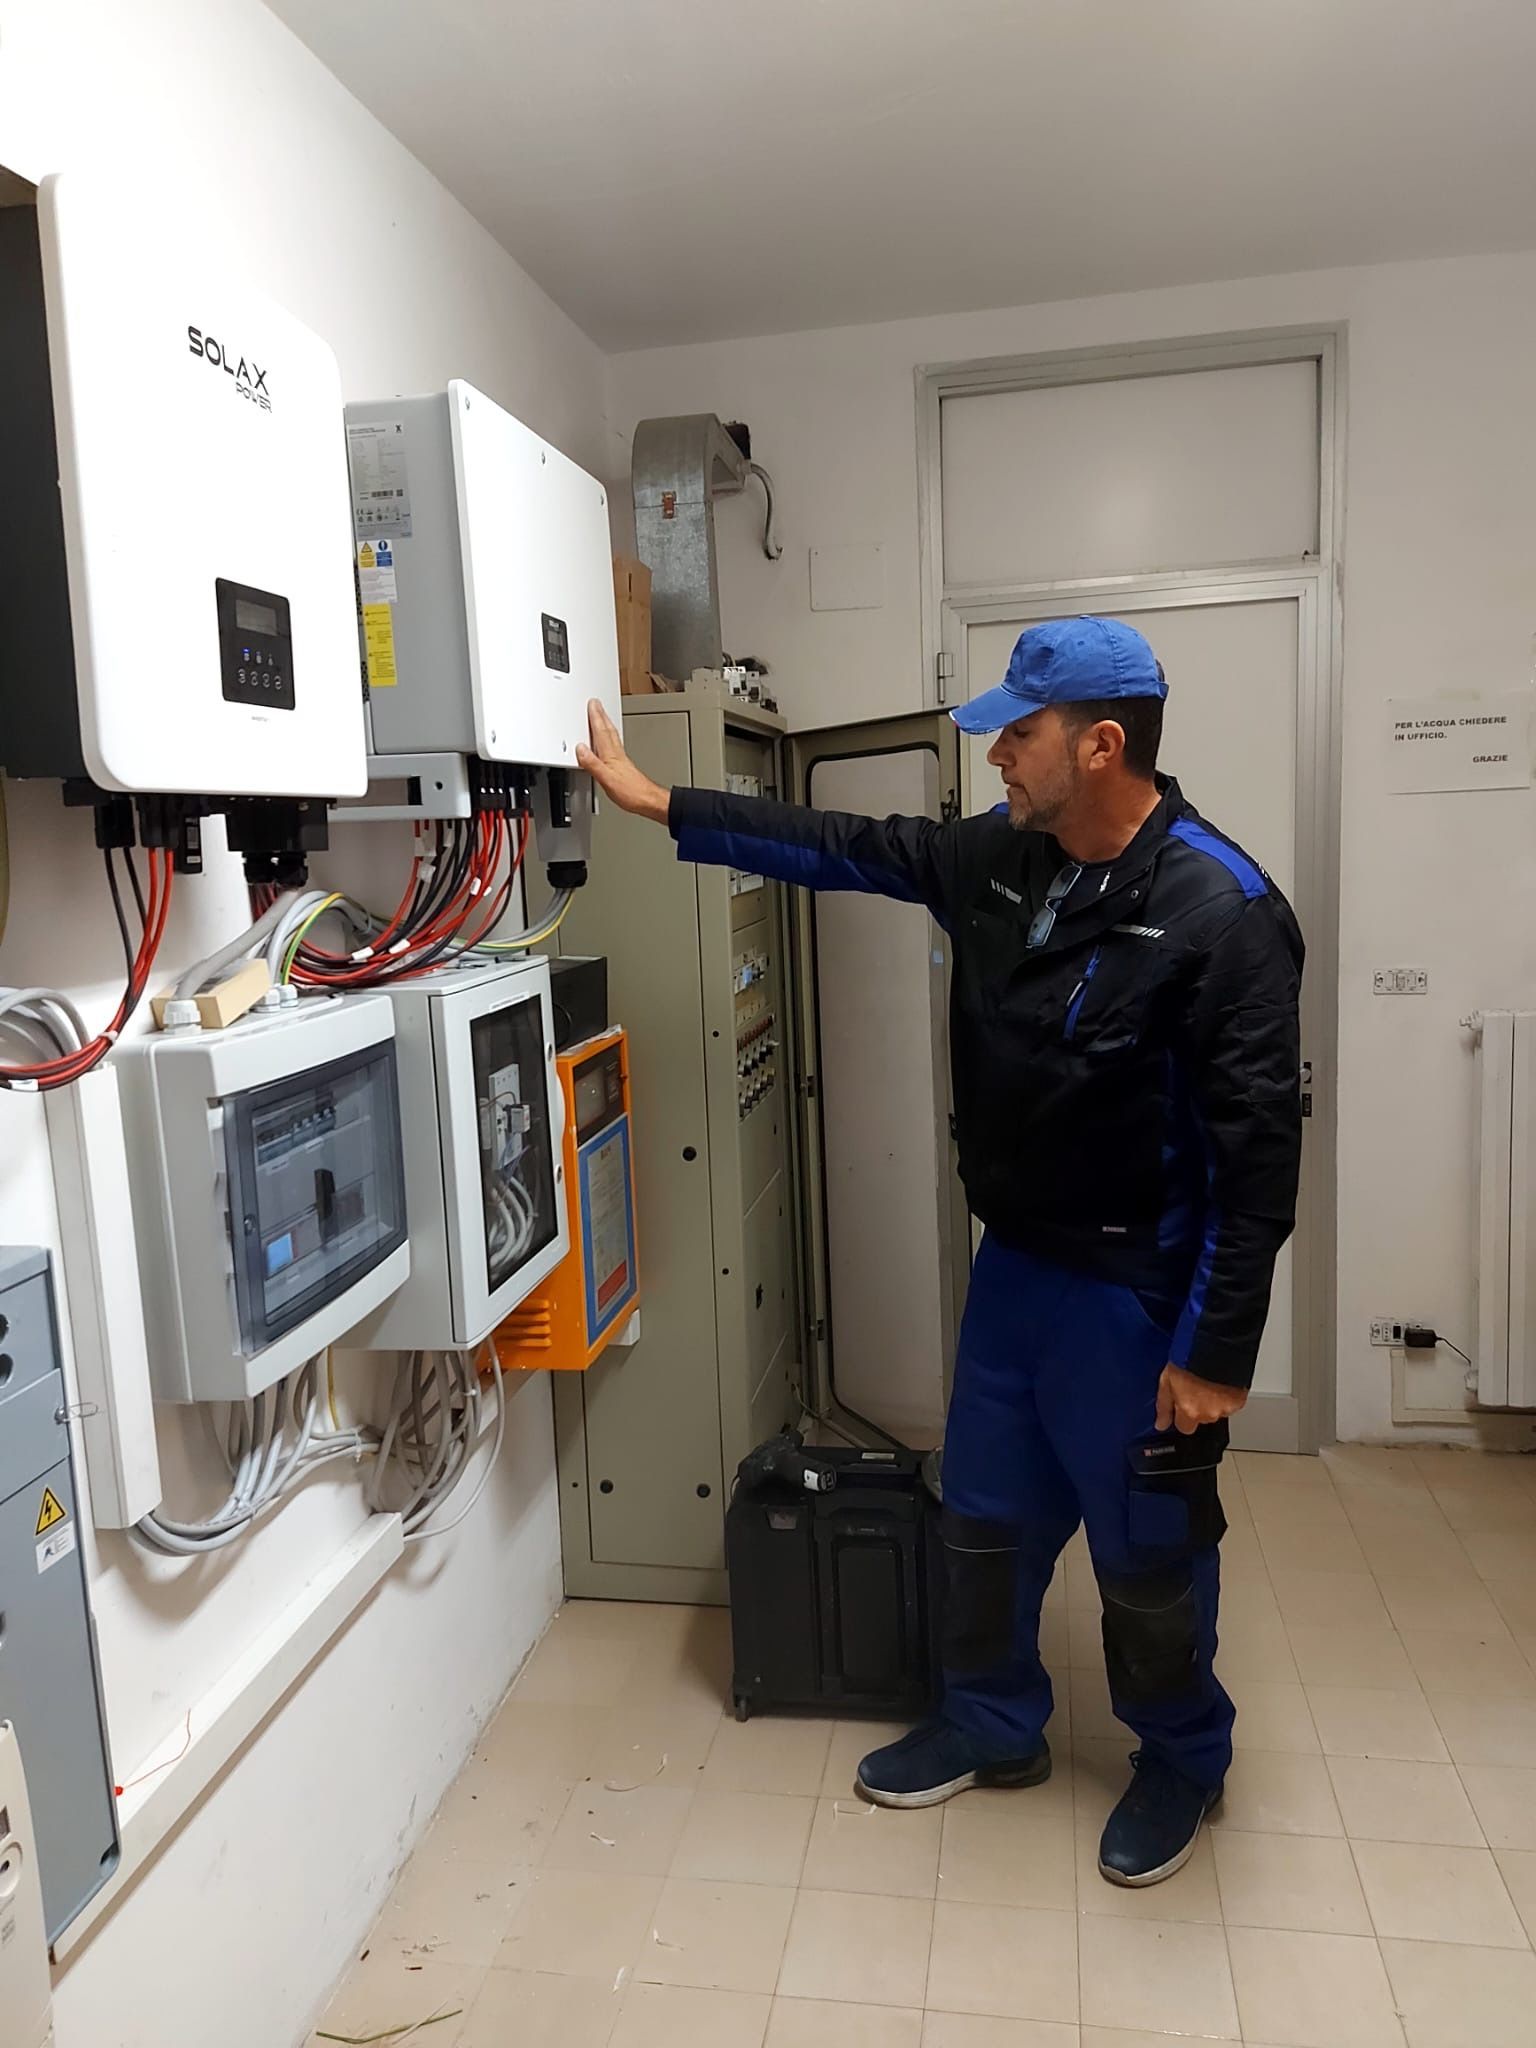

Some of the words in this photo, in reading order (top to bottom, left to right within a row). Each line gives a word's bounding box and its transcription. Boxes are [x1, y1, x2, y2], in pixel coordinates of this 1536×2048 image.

[188, 325, 269, 396] SOLAX
[236, 381, 272, 414] POWER
[1394, 721, 1413, 729] PER
[1415, 719, 1456, 728] L'ACQUA
[1459, 716, 1507, 726] CHIEDERE
[1394, 733, 1405, 741] IN
[1407, 731, 1448, 740] UFFICIO.
[1472, 754, 1509, 763] GRAZIE
